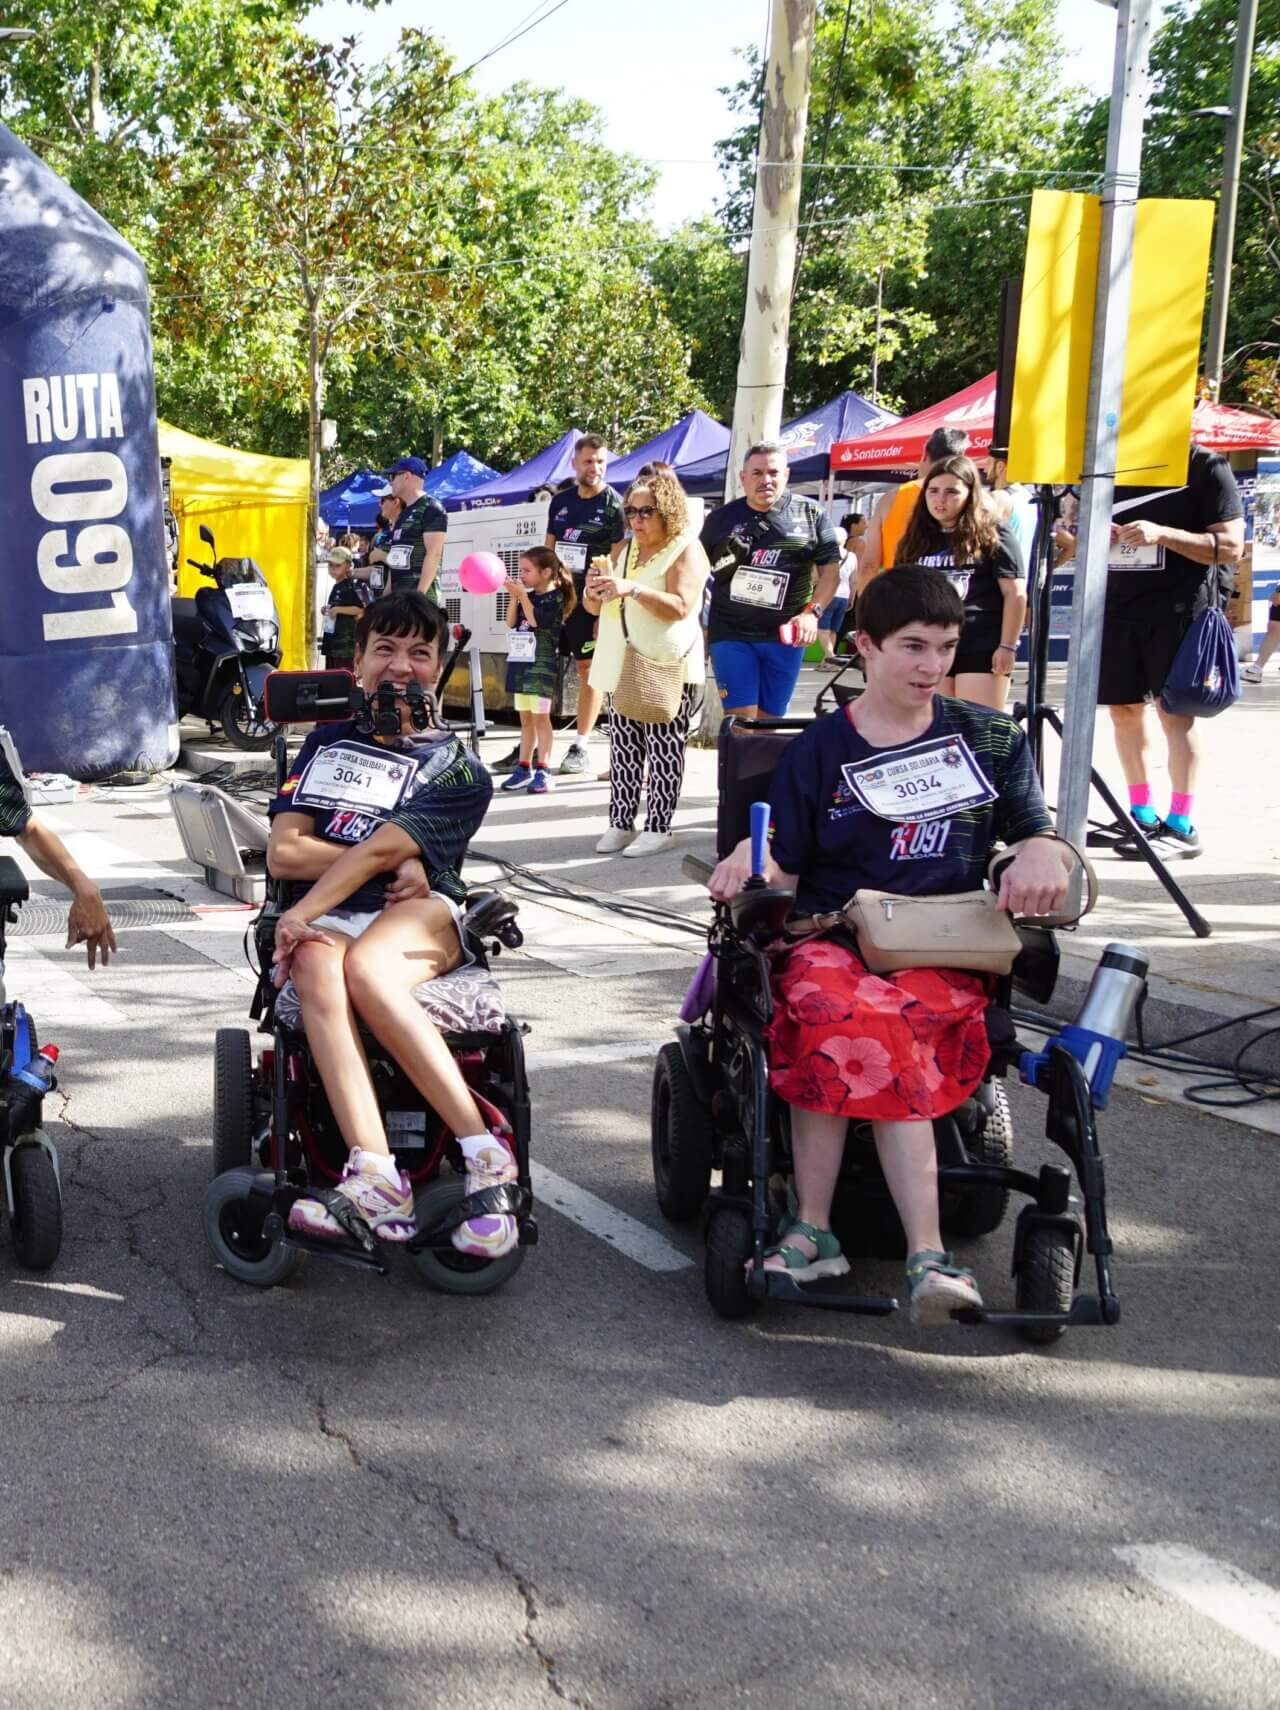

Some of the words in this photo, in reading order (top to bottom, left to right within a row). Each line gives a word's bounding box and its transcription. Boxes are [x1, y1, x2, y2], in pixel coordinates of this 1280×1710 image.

[23, 373, 124, 444] RUTA
[853, 445, 903, 461] Santander
[31, 451, 138, 641] 091
[746, 583, 763, 592] 368
[339, 752, 359, 764] CURSA
[333, 767, 372, 789] 3041
[886, 764, 909, 777] CURSA
[894, 775, 942, 798] 3034
